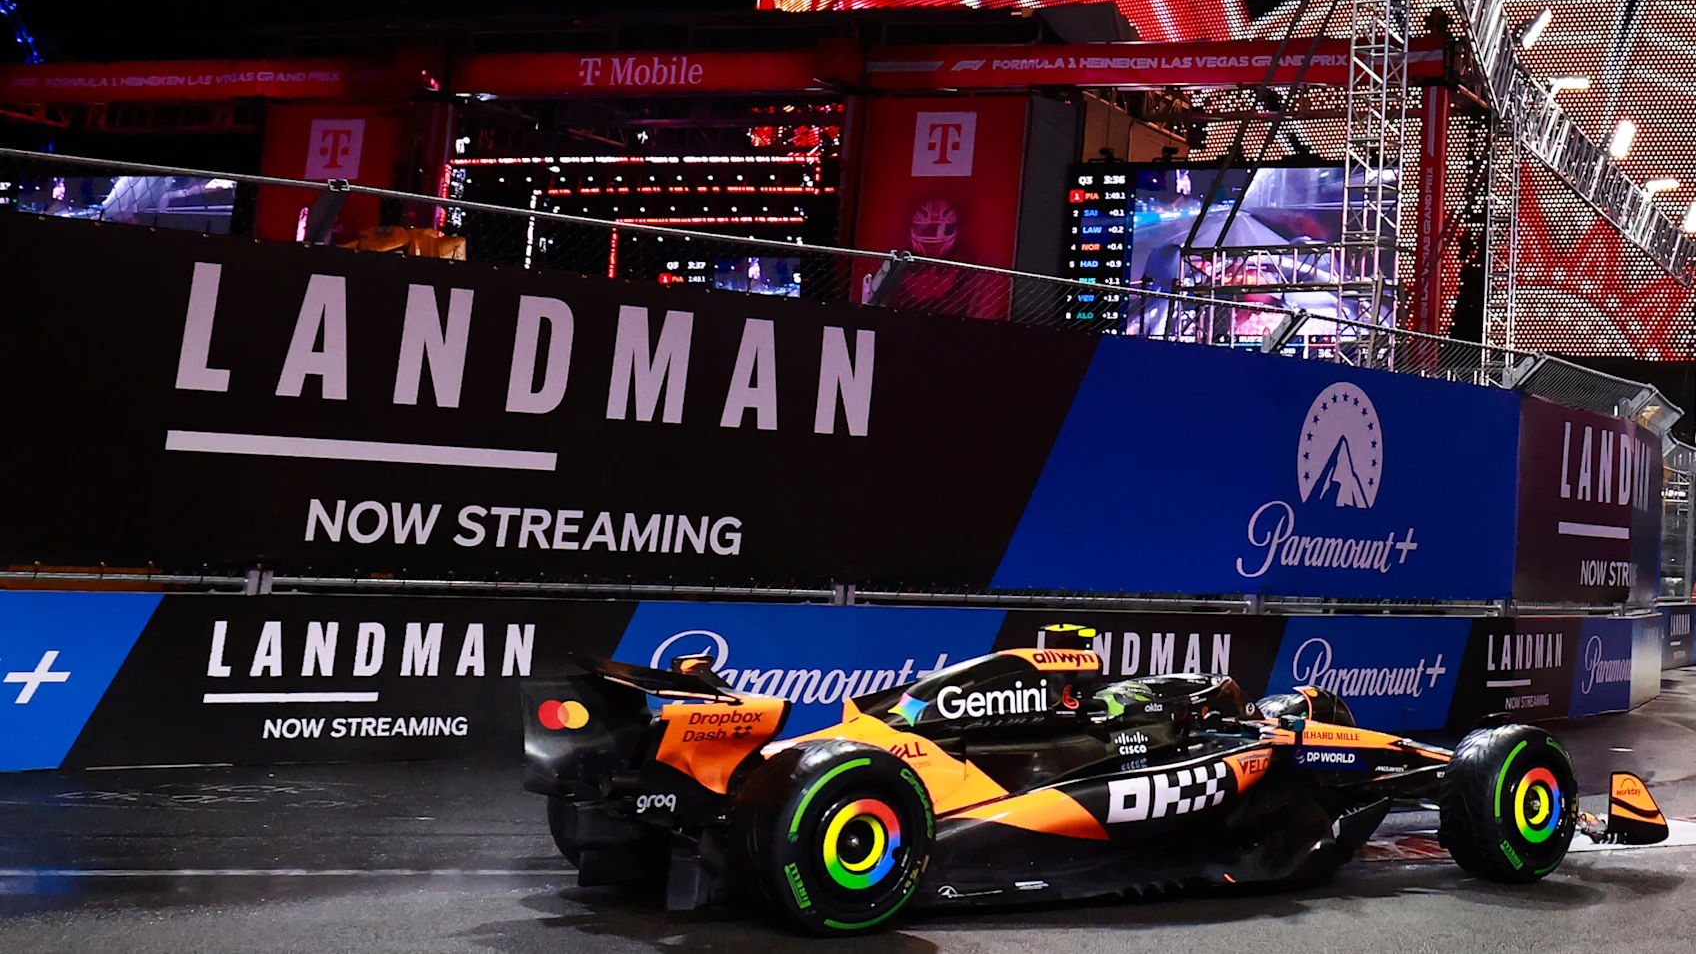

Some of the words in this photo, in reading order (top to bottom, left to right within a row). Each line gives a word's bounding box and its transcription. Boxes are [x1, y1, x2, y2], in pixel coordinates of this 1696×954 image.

[610, 56, 703, 85] Mobile
[992, 57, 1065, 71] FORMULA
[1068, 57, 1077, 69] 1
[1079, 57, 1158, 69] HEINEKEN
[1161, 57, 1192, 69] LAS
[1195, 56, 1249, 68] VEGAS
[1309, 54, 1348, 67] PRIX
[1078, 176, 1093, 186] Q3
[1085, 192, 1099, 200] PIA
[1082, 226, 1102, 234] LAW
[1081, 243, 1100, 251] NOR
[1080, 260, 1099, 268] HAD
[175, 262, 876, 436] LANDMAN
[304, 499, 442, 545] NOW
[453, 505, 743, 556] STREAMING
[1236, 500, 1418, 578] Paramount+
[1579, 560, 1607, 586] NOW
[207, 620, 536, 677] LANDMAN
[1487, 633, 1563, 671] LANDMAN
[1033, 650, 1095, 667] allwyn
[1293, 637, 1446, 699] Paramount+
[936, 678, 1048, 720] Gemini
[1145, 698, 1163, 713] okta
[689, 710, 763, 726] Dropbox
[262, 718, 326, 739] NOW
[330, 716, 468, 738] STREAMING
[682, 728, 727, 743] Dash
[1303, 731, 1334, 740] ICHARD
[1336, 732, 1360, 741] MILLE
[1306, 751, 1320, 763] DP
[1321, 752, 1355, 764] WORLD
[1616, 787, 1641, 797] workday
[636, 793, 677, 814] groq
